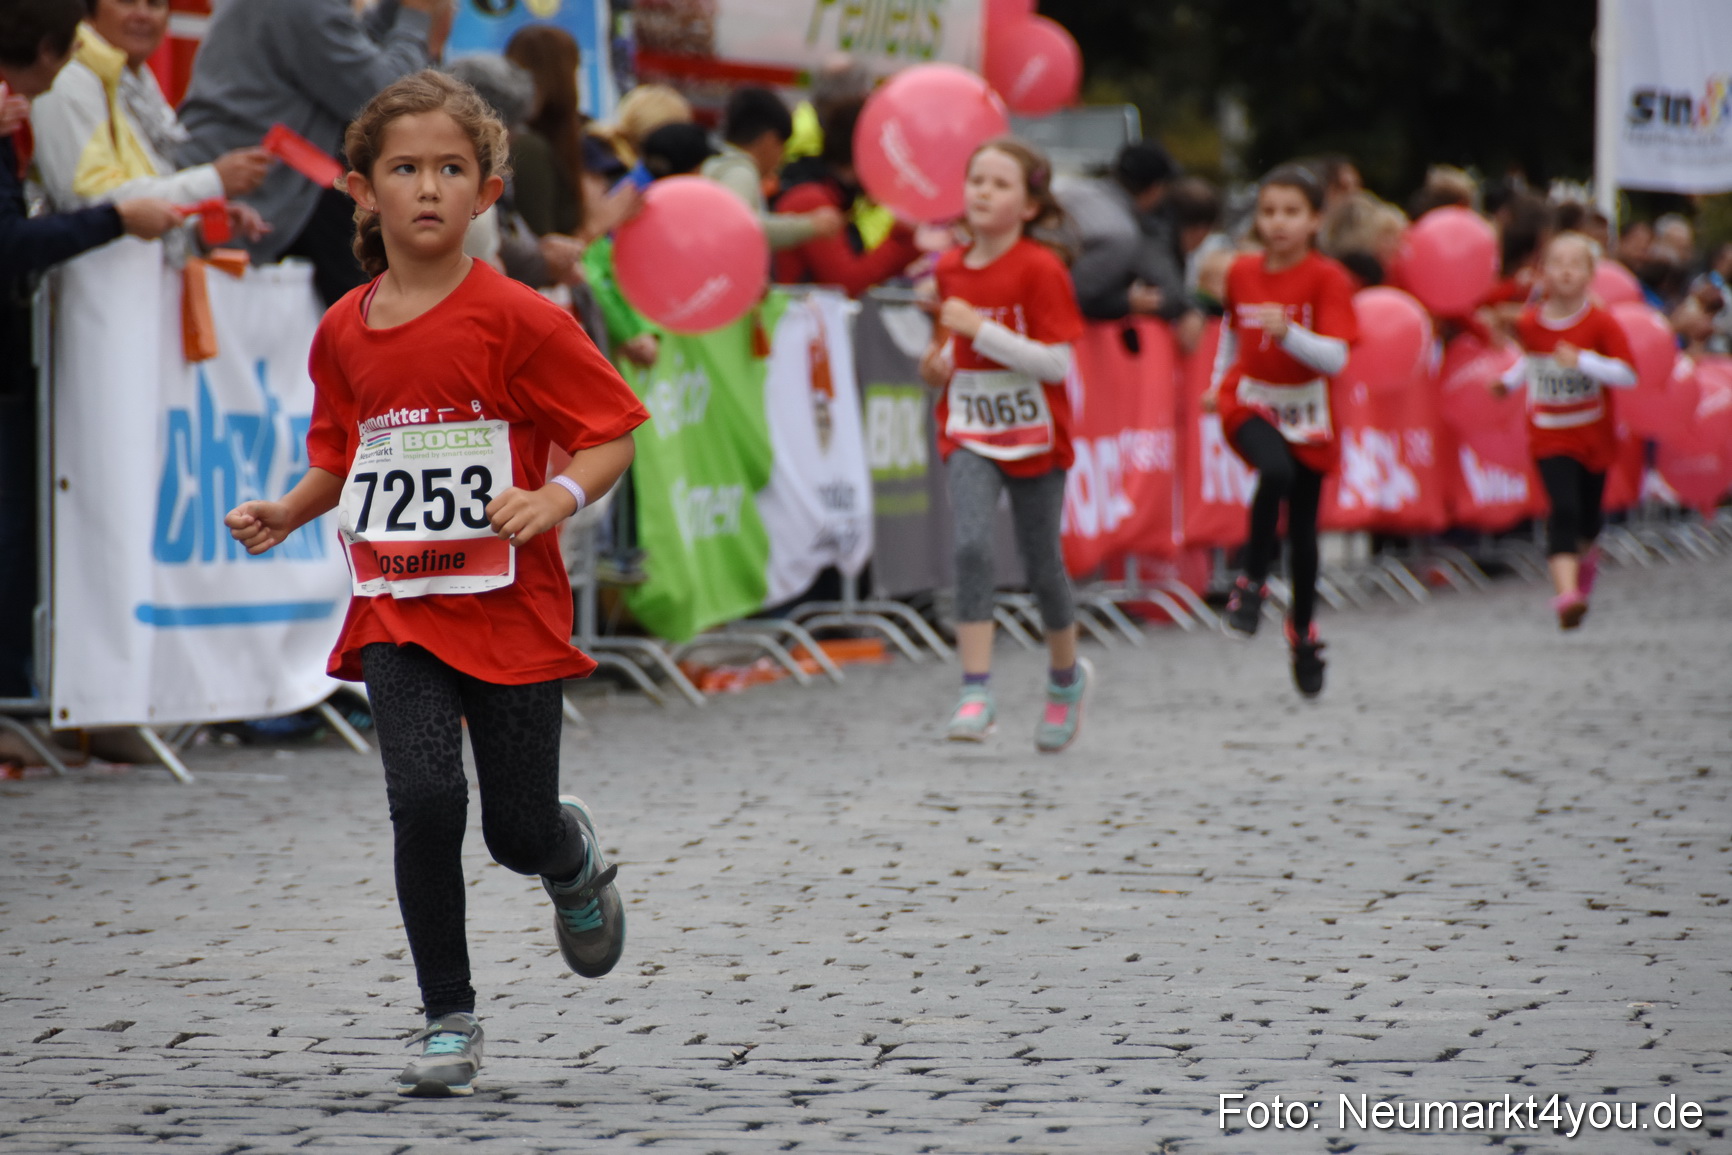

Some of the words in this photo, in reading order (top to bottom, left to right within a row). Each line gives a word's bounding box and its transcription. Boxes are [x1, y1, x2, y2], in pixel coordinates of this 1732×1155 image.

[357, 407, 429, 437] eumarkter
[958, 389, 1039, 427] 7065
[402, 427, 494, 452] BOCK
[403, 452, 430, 460] inspired
[432, 451, 440, 459] by
[464, 448, 494, 458] concepts
[353, 464, 494, 534] 7253
